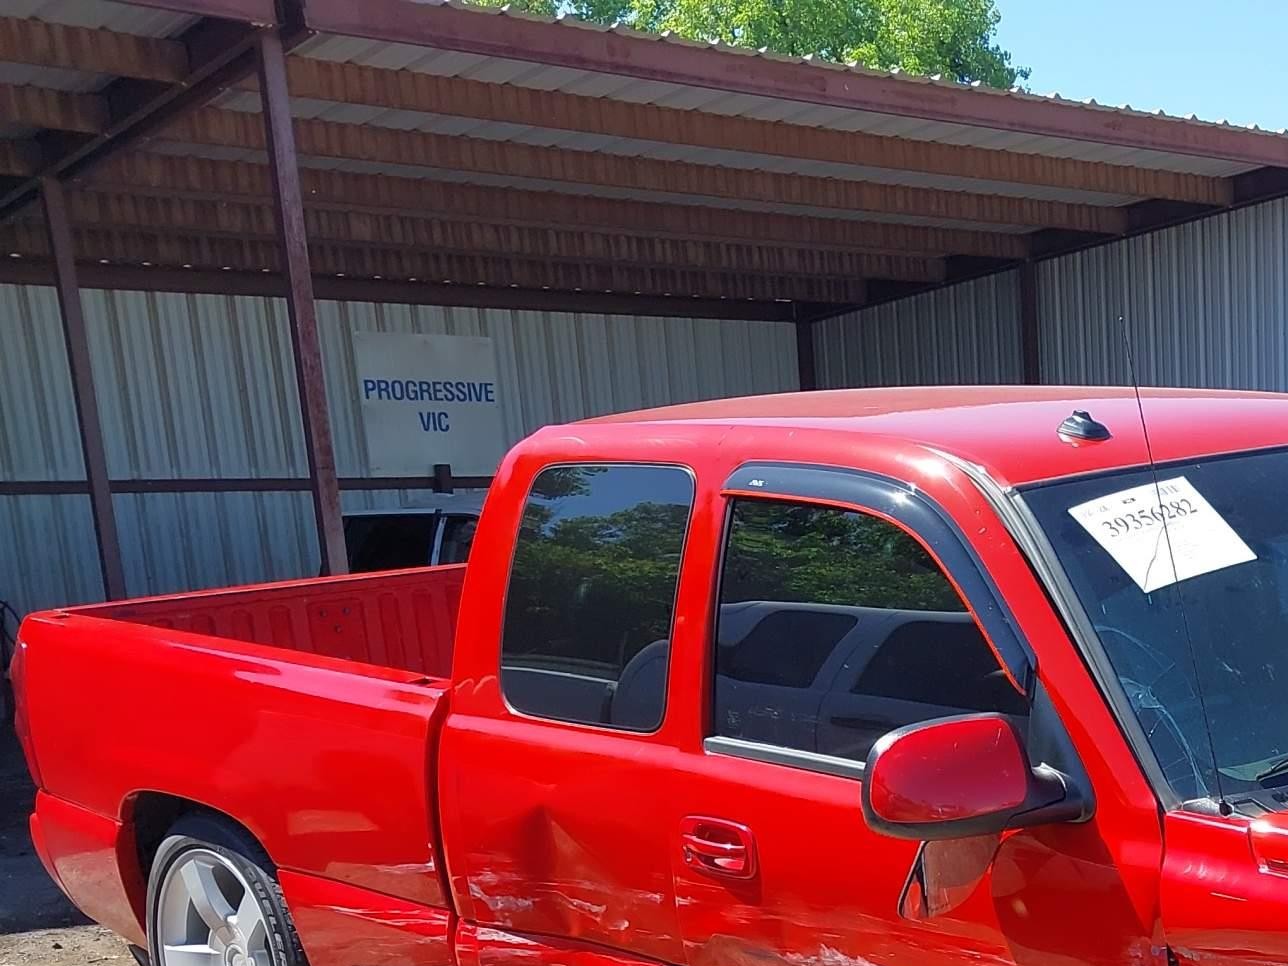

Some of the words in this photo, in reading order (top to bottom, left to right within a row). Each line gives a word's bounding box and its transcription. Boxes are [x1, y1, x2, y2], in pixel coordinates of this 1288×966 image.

[363, 378, 496, 403] PROGRESSIVE
[418, 411, 450, 432] VIC
[1102, 498, 1198, 538] 39356282
